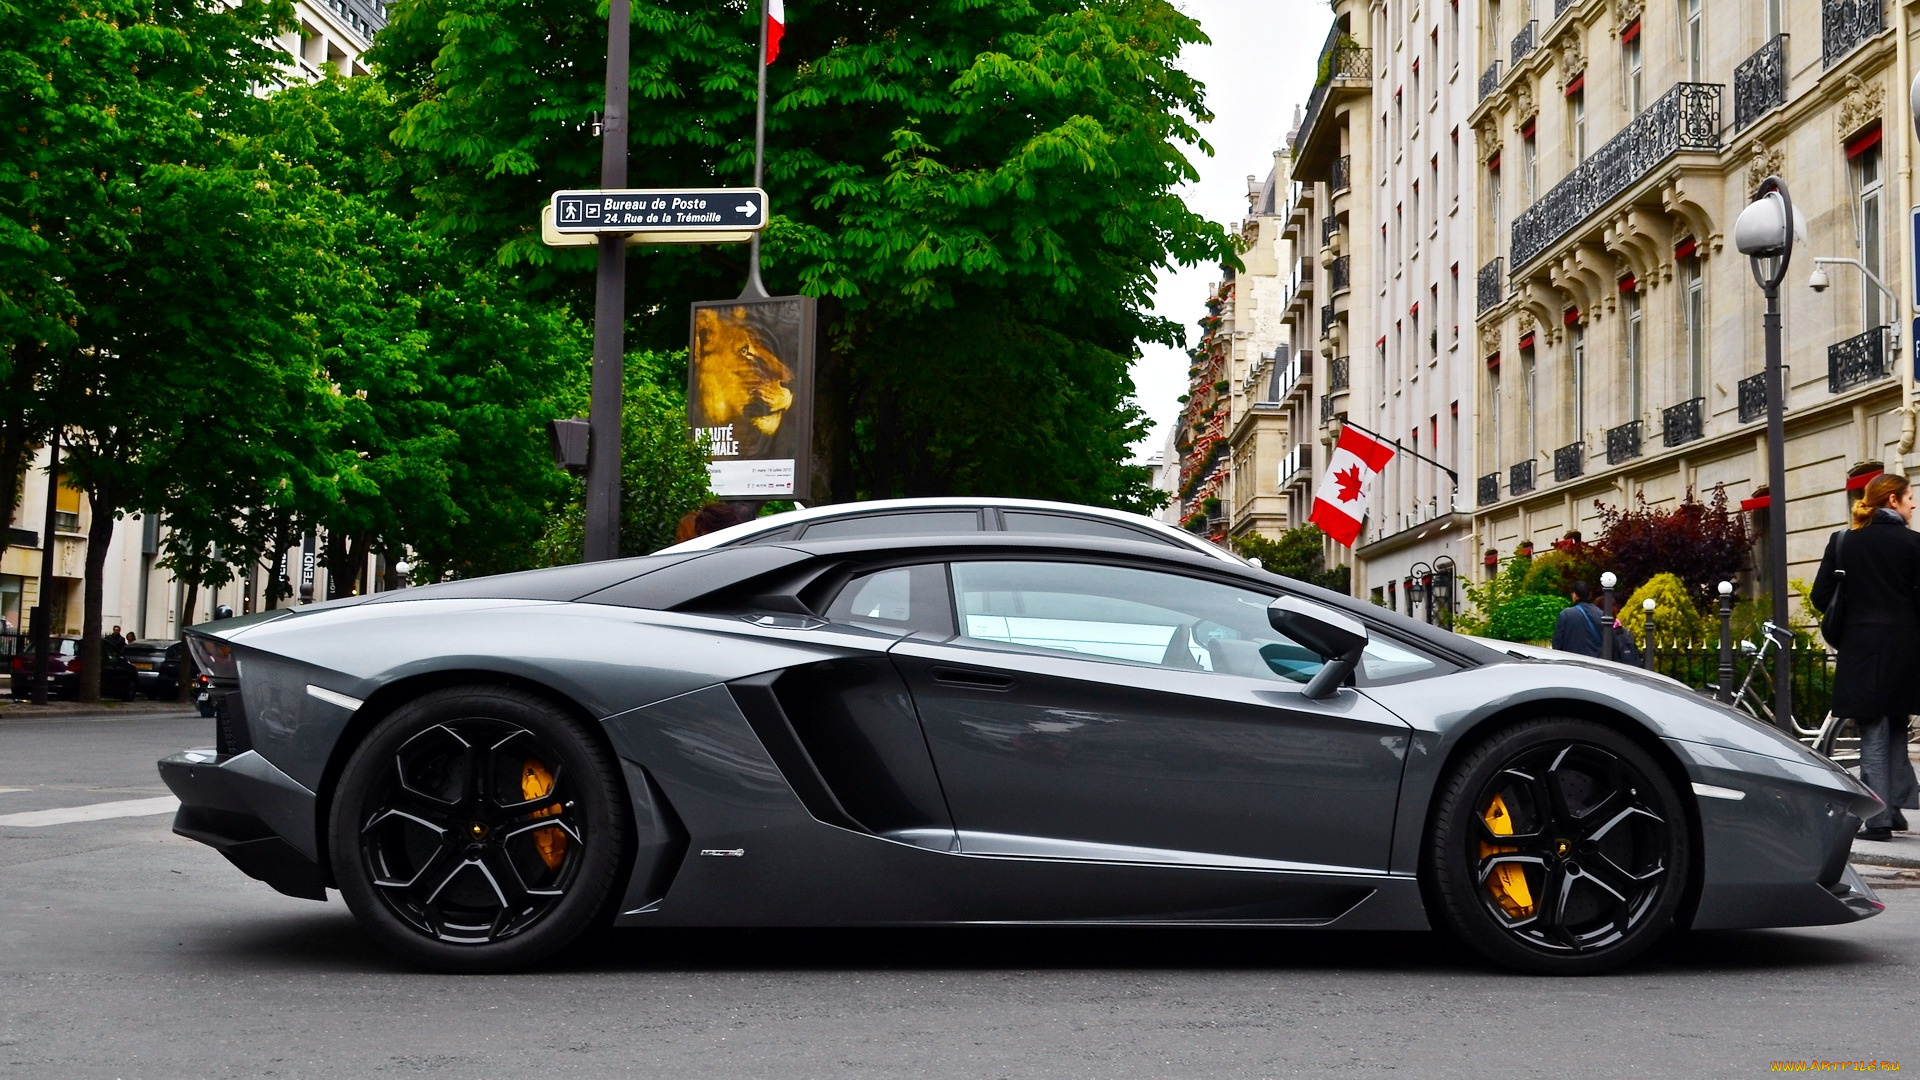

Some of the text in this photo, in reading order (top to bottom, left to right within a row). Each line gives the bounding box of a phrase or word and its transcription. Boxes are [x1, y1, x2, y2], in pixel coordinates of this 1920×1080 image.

[604, 198, 707, 211] Bureau de Poste
[604, 212, 722, 224] 24. Rue de la Trémoille
[702, 440, 740, 456] MALE
[303, 552, 315, 584] FENDI
